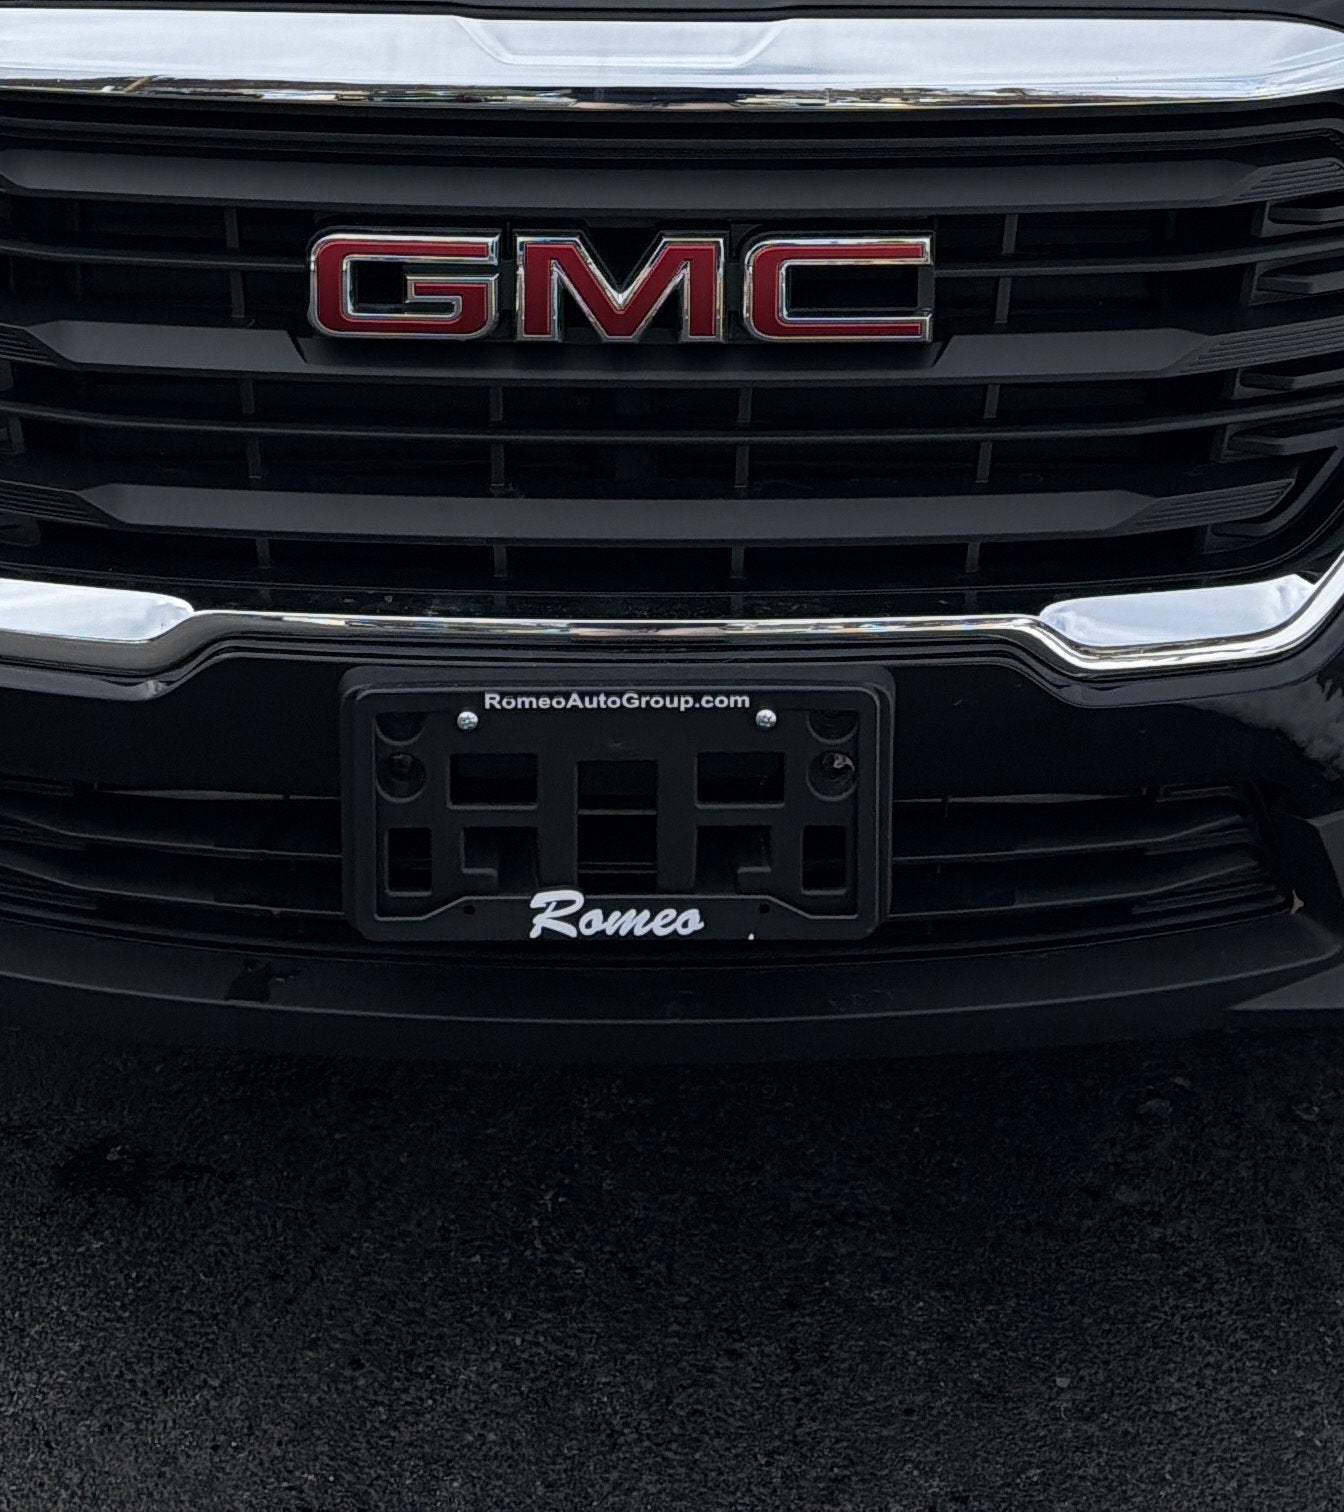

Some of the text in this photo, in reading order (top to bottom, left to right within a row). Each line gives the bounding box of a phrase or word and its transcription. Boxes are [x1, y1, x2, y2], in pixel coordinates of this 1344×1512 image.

[310, 233, 933, 342] GMC
[484, 692, 750, 711] RomeoAutoGroup.com
[529, 890, 704, 938] Romeo
